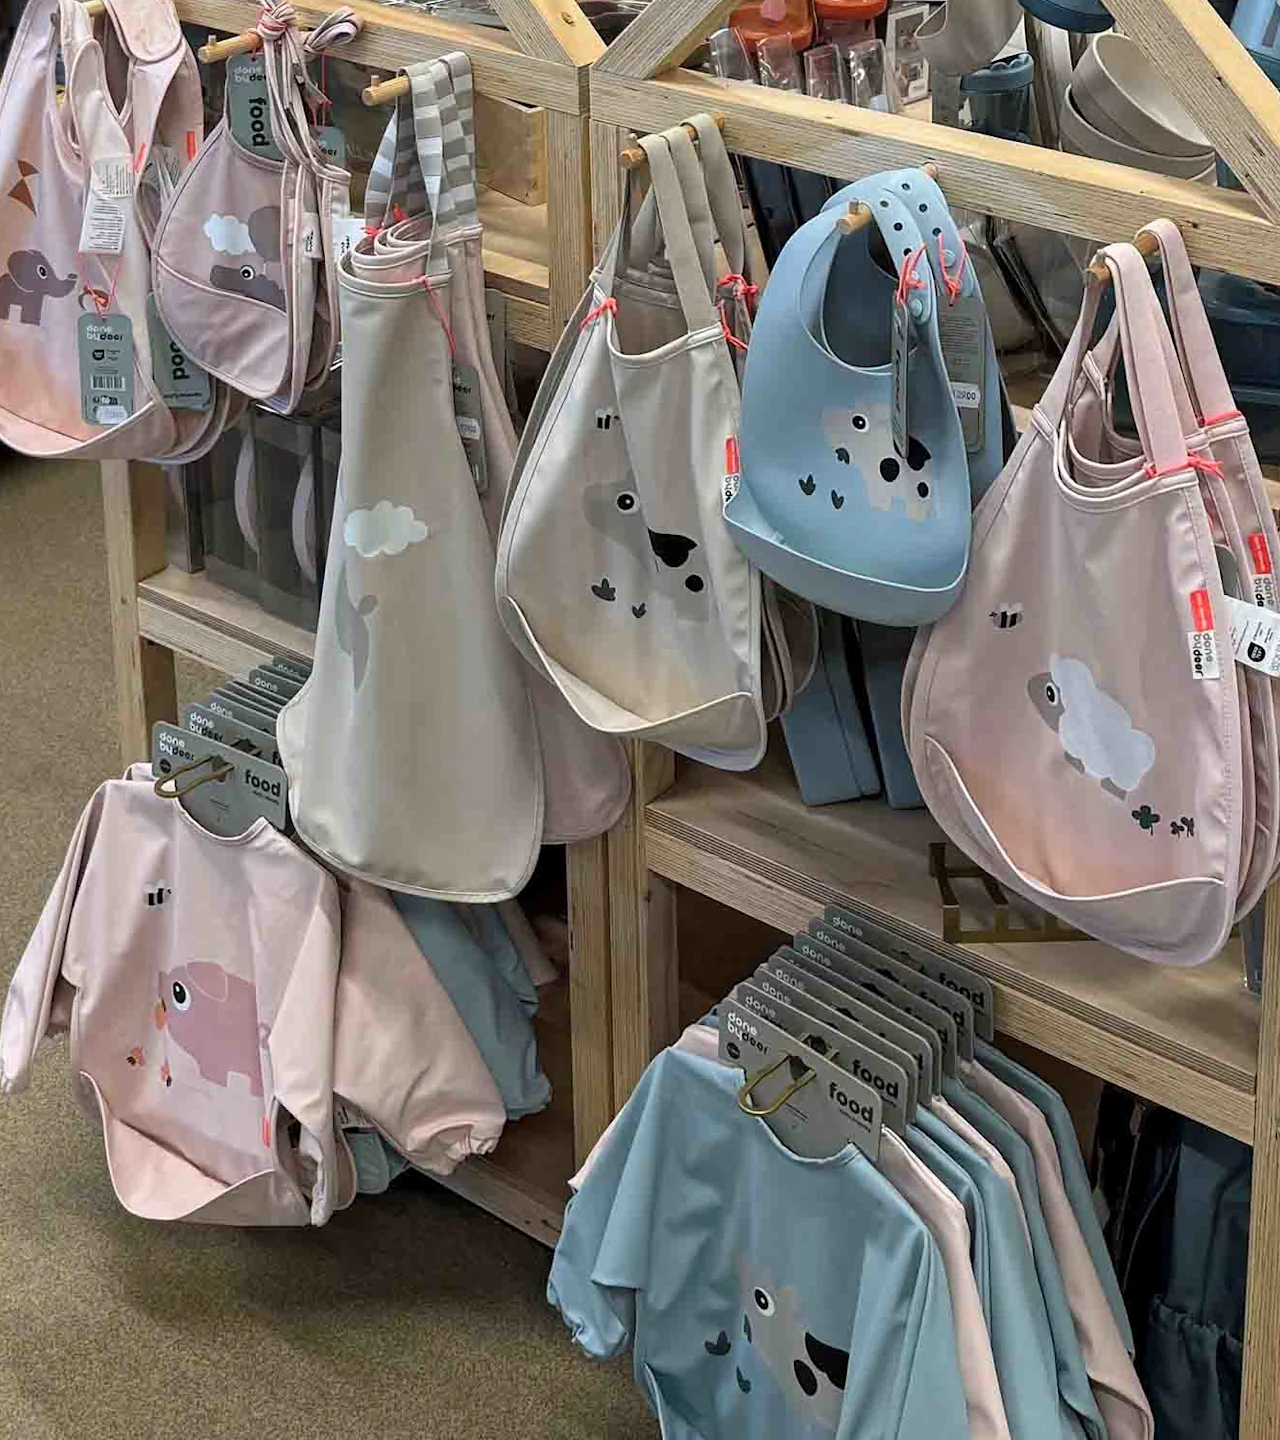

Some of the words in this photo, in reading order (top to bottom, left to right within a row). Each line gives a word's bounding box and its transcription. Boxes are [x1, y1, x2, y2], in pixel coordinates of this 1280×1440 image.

[249, 96, 270, 147] food
[169, 341, 190, 381] ood
[190, 711, 215, 729] done
[160, 732, 186, 749] done
[245, 769, 282, 798] food
[832, 916, 863, 939] done
[816, 929, 846, 953] done
[802, 944, 832, 968] done
[762, 980, 793, 1006] done
[745, 994, 777, 1019] done
[727, 1010, 759, 1038] done
[852, 1059, 899, 1100] food
[829, 1081, 874, 1119] food
